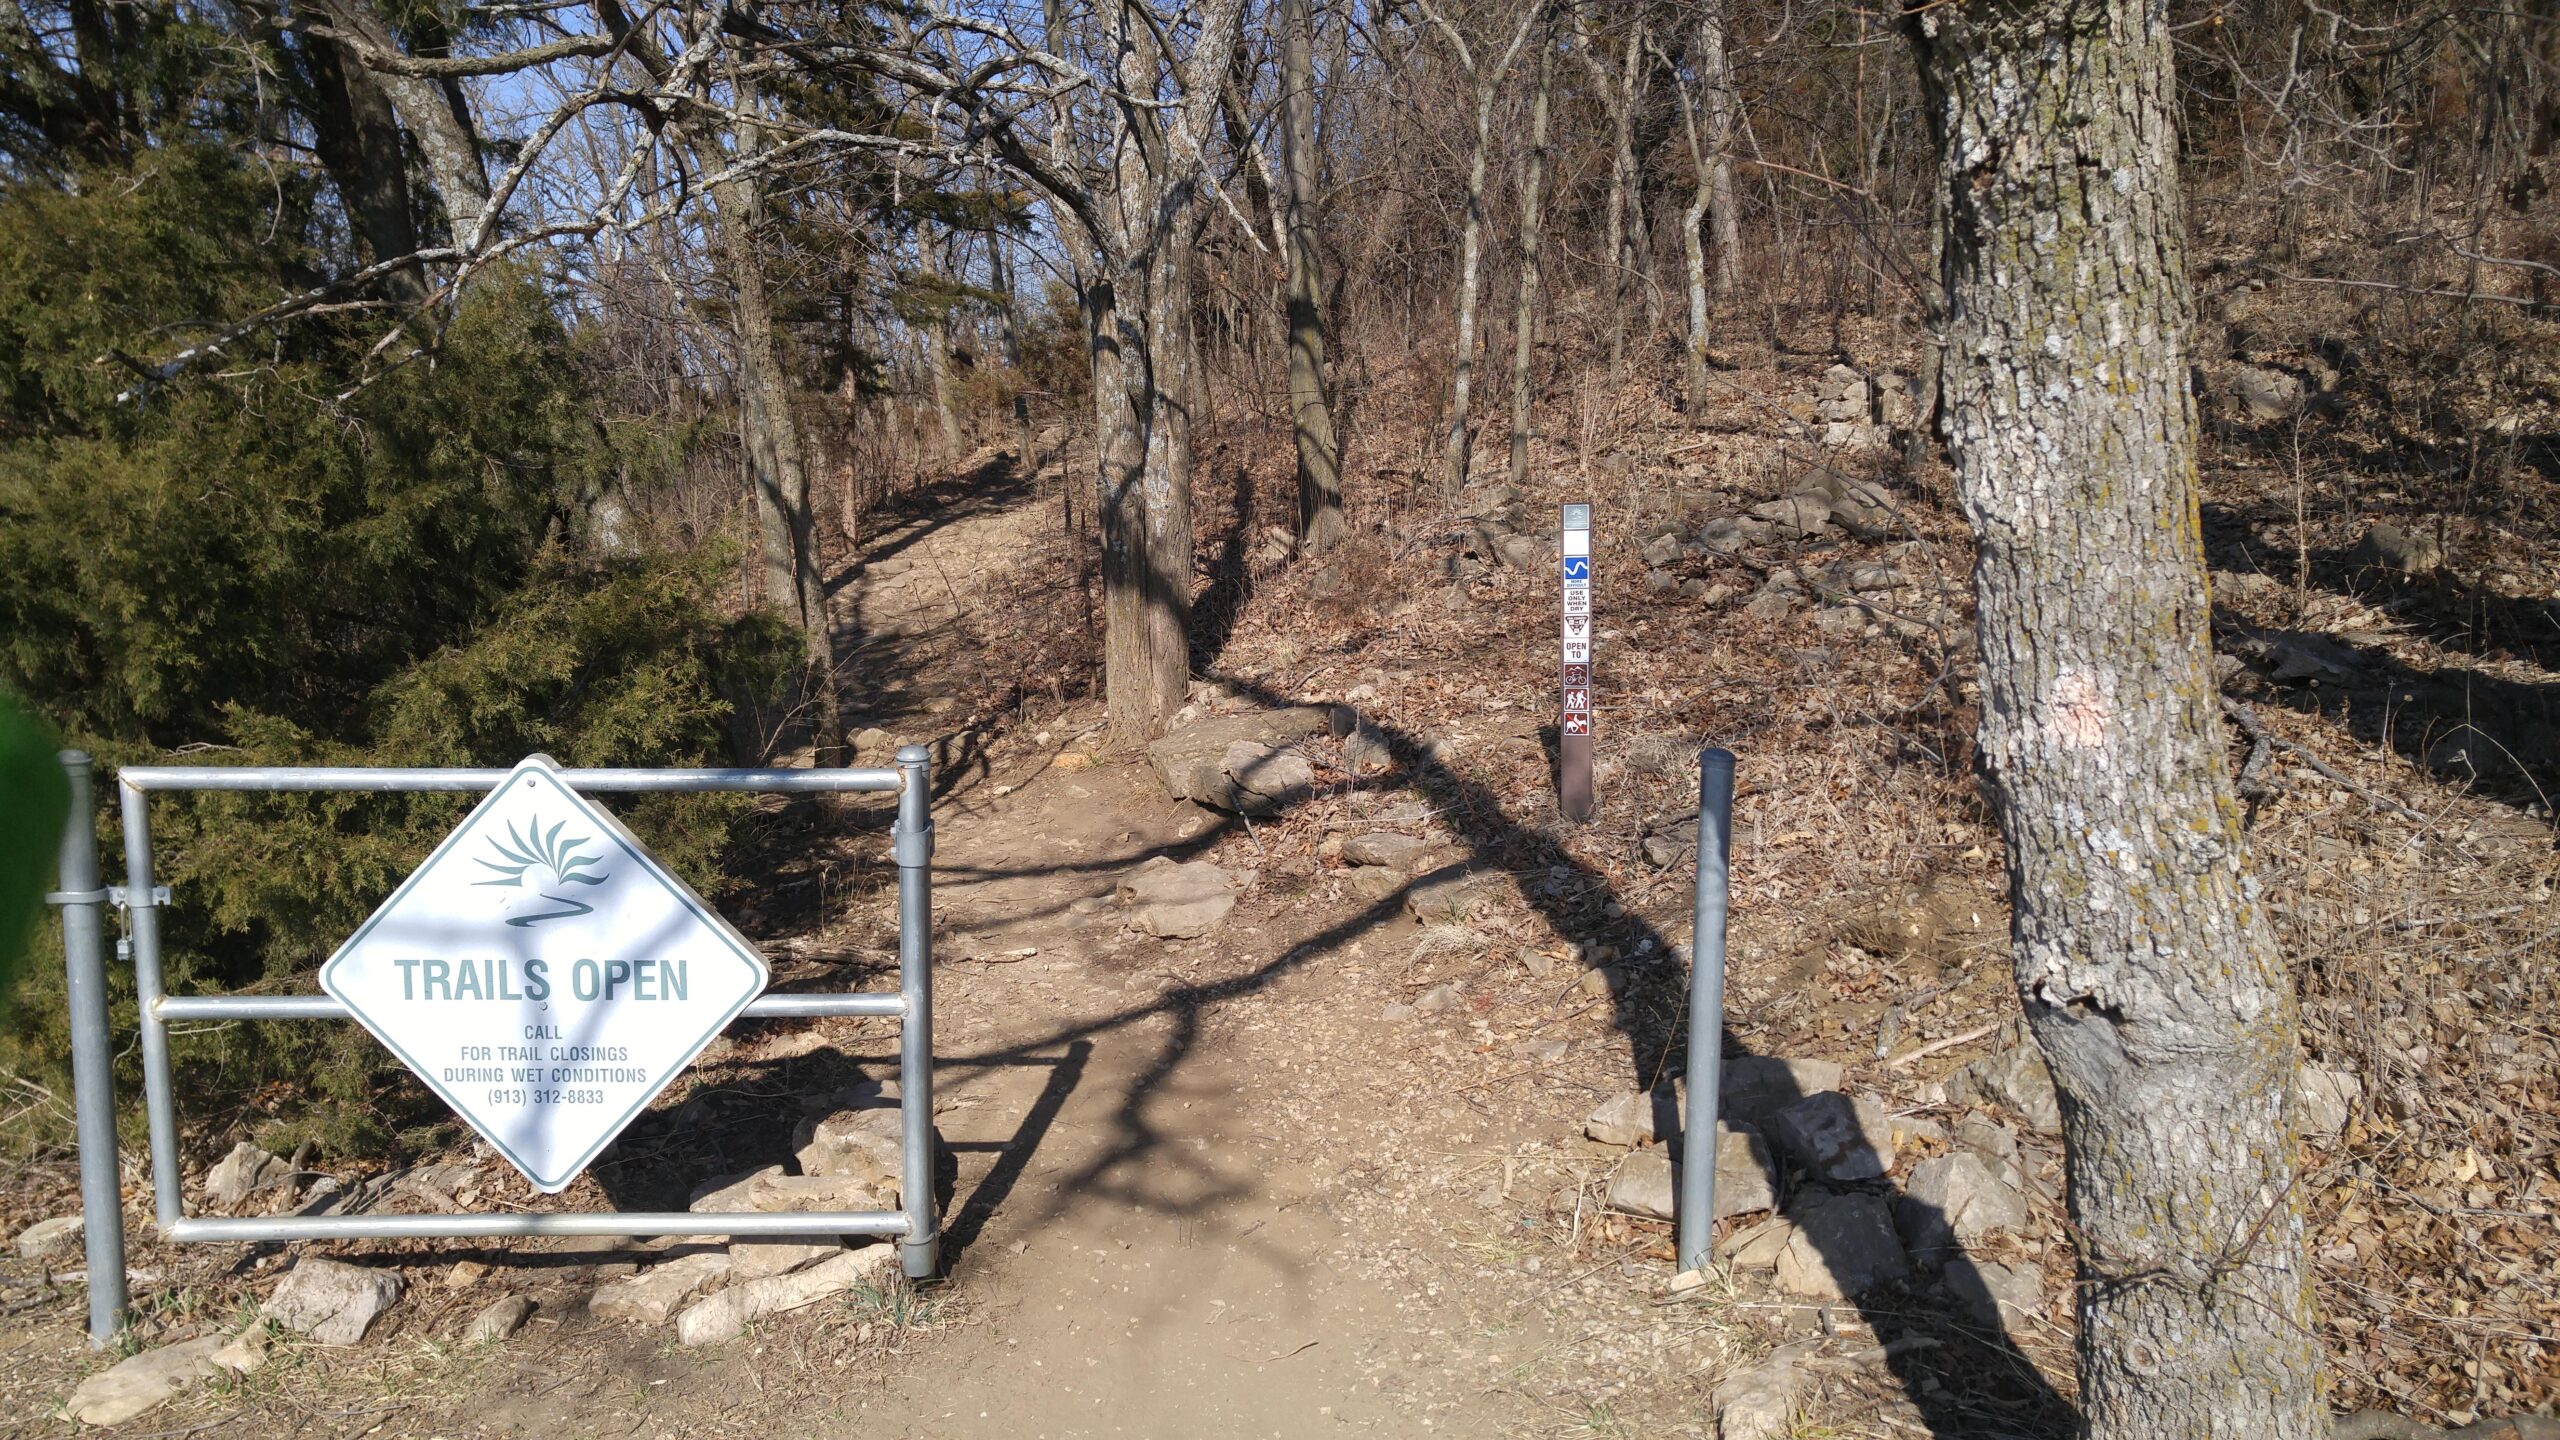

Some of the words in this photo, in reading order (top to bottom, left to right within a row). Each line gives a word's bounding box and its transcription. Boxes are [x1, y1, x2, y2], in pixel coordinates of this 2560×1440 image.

[1571, 651, 1582, 659] TO
[394, 958, 551, 1001] TRAILS
[572, 958, 688, 1001] OPEN
[524, 1025, 563, 1040] CALL
[461, 1046, 491, 1061] FOR
[497, 1046, 543, 1061] TRAIL
[550, 1046, 629, 1061] CLOSINGS
[444, 1067, 504, 1083] DURING
[511, 1067, 544, 1083] WET
[551, 1067, 647, 1083] CONDITIONS
[488, 1089, 527, 1106] (913)
[534, 1090, 604, 1104] 312-8833
